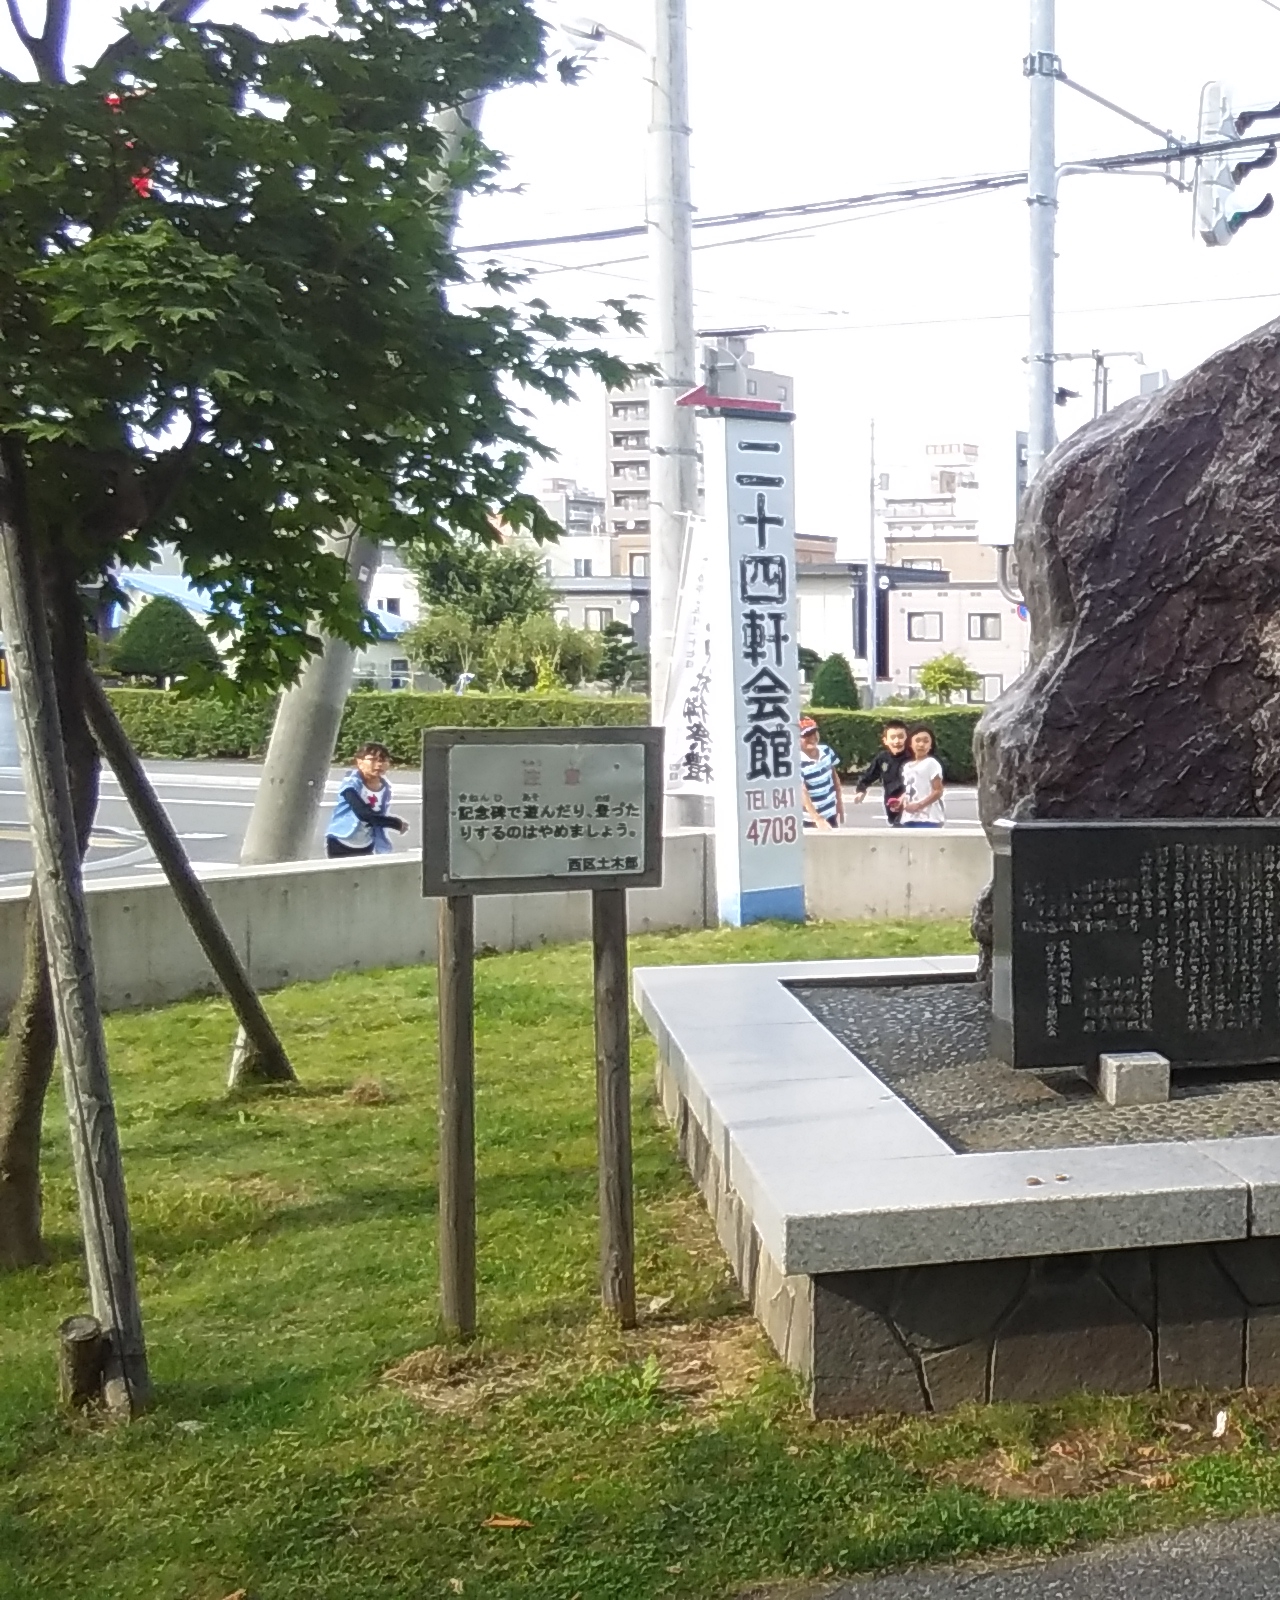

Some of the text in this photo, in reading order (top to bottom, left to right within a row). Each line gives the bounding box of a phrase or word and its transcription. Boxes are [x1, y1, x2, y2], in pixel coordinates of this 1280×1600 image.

[735, 438, 794, 781] 二十四軒会館
[745, 787, 794, 810] TEL 641
[460, 822, 637, 841] りするのはやめましょう。
[746, 815, 797, 846] 4703
[568, 856, 639, 872] 西区土木部
